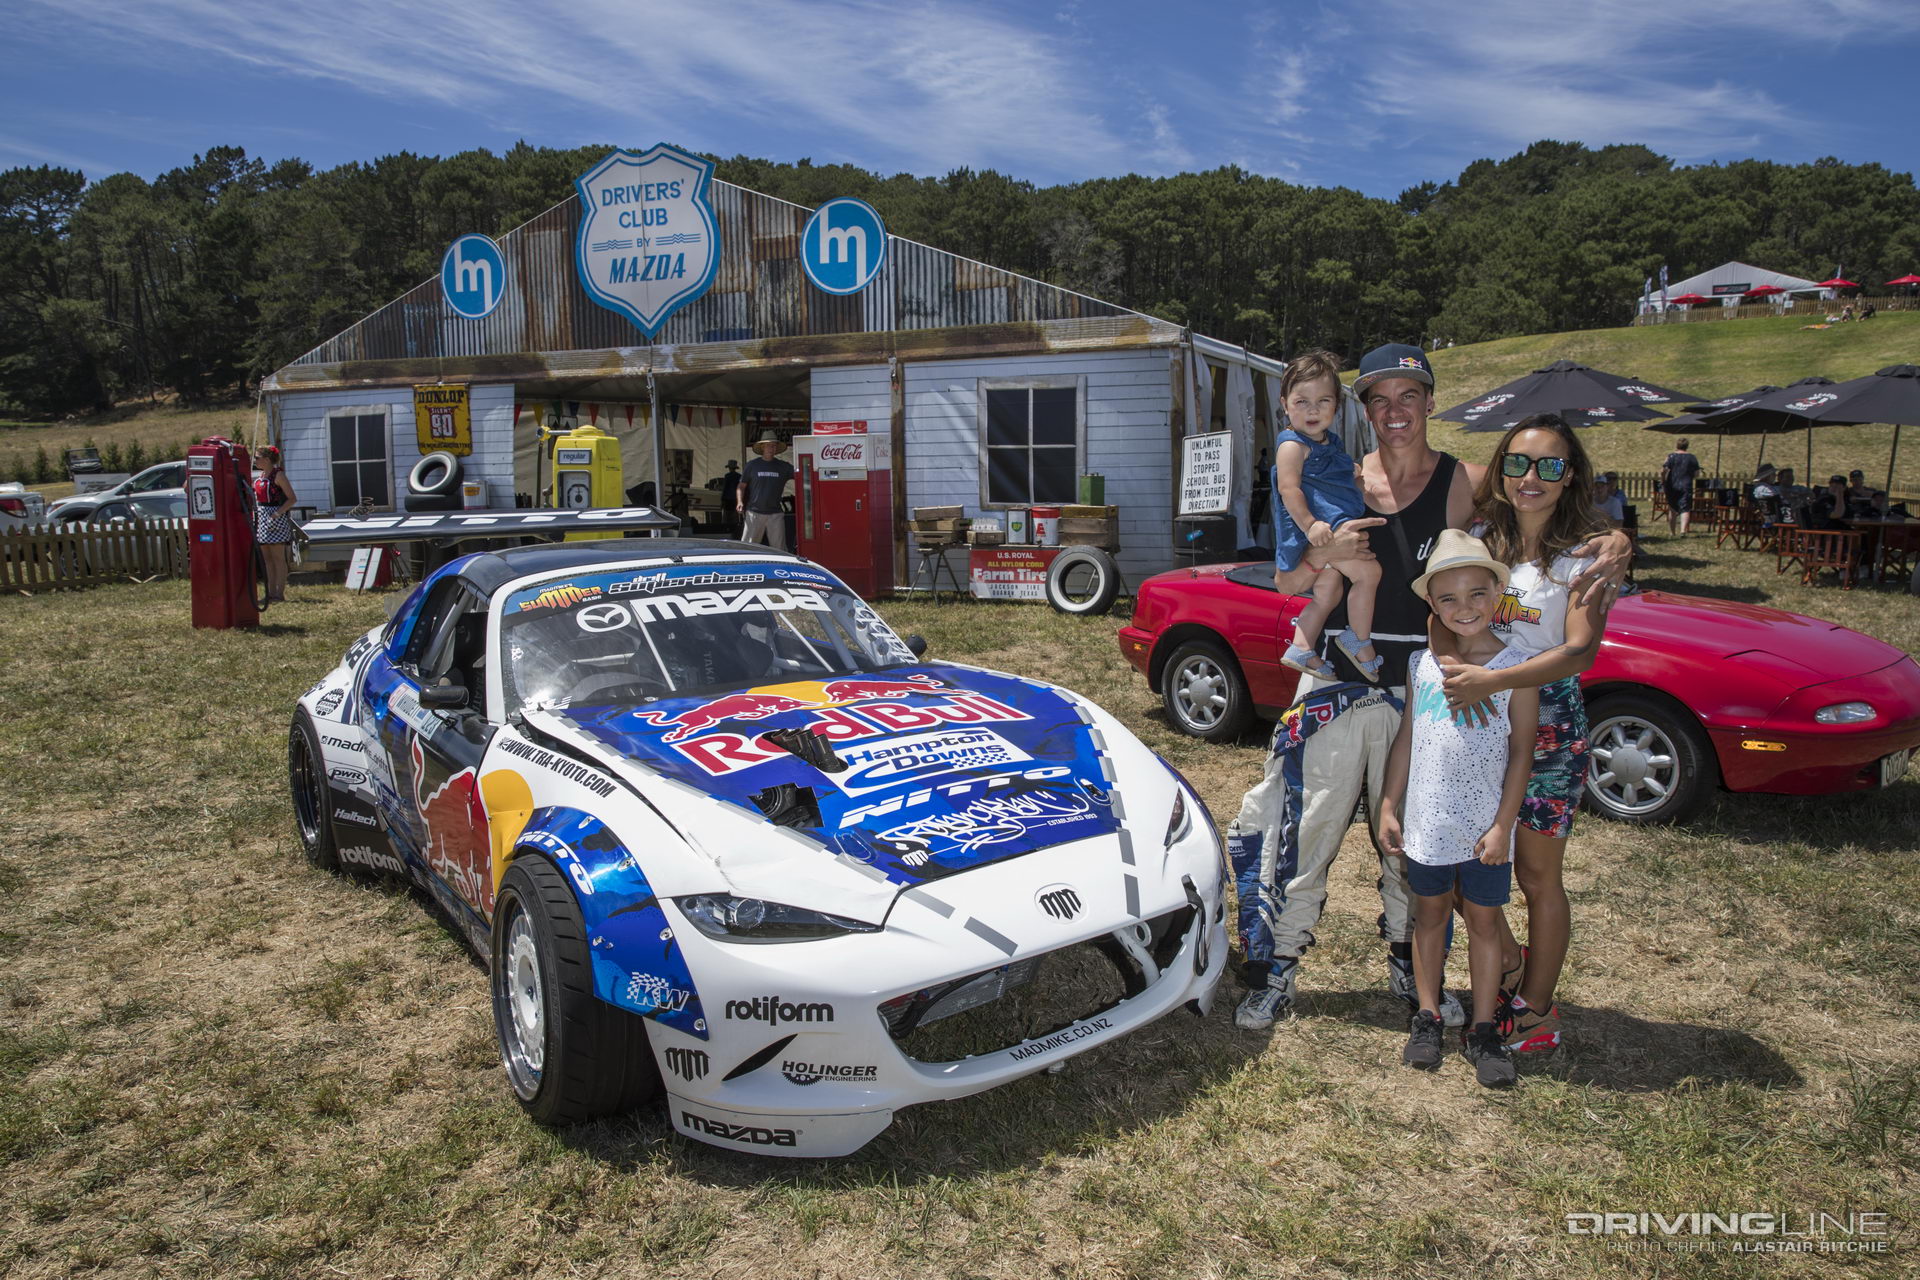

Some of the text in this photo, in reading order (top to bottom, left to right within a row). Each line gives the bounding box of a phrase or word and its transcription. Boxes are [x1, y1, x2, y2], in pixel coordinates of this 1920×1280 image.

[602, 179, 685, 206] DRIVERS'
[618, 208, 668, 228] CLUB
[637, 238, 651, 248] BY
[609, 253, 687, 285] MAZDA
[418, 389, 464, 403] DUNLOP
[431, 414, 453, 436] 90
[821, 443, 864, 460] Coca-Cola
[1192, 438, 1222, 451] UNLAWFUL
[1194, 450, 1220, 462] TO PASS
[1193, 462, 1219, 474] STOPPED
[1186, 474, 1226, 487] SCHOOL BUS
[1185, 486, 1225, 499] FROM EITHER
[1188, 499, 1219, 510] DIRECTION
[973, 568, 1015, 582] Farm
[520, 586, 603, 612] SUMMER
[848, 695, 1035, 731] Bull
[847, 733, 996, 767] Hampton
[891, 744, 1006, 771] Downs
[505, 739, 617, 798] WWW.TRA-KYOTO.COM
[838, 766, 1072, 829] NITTO
[334, 808, 377, 827] Haltech
[340, 845, 407, 873] rotiform
[725, 996, 834, 1026] rotiform
[1009, 1018, 1114, 1061] MADMIKE.CO.NZ
[782, 1060, 878, 1077] HOLINGER
